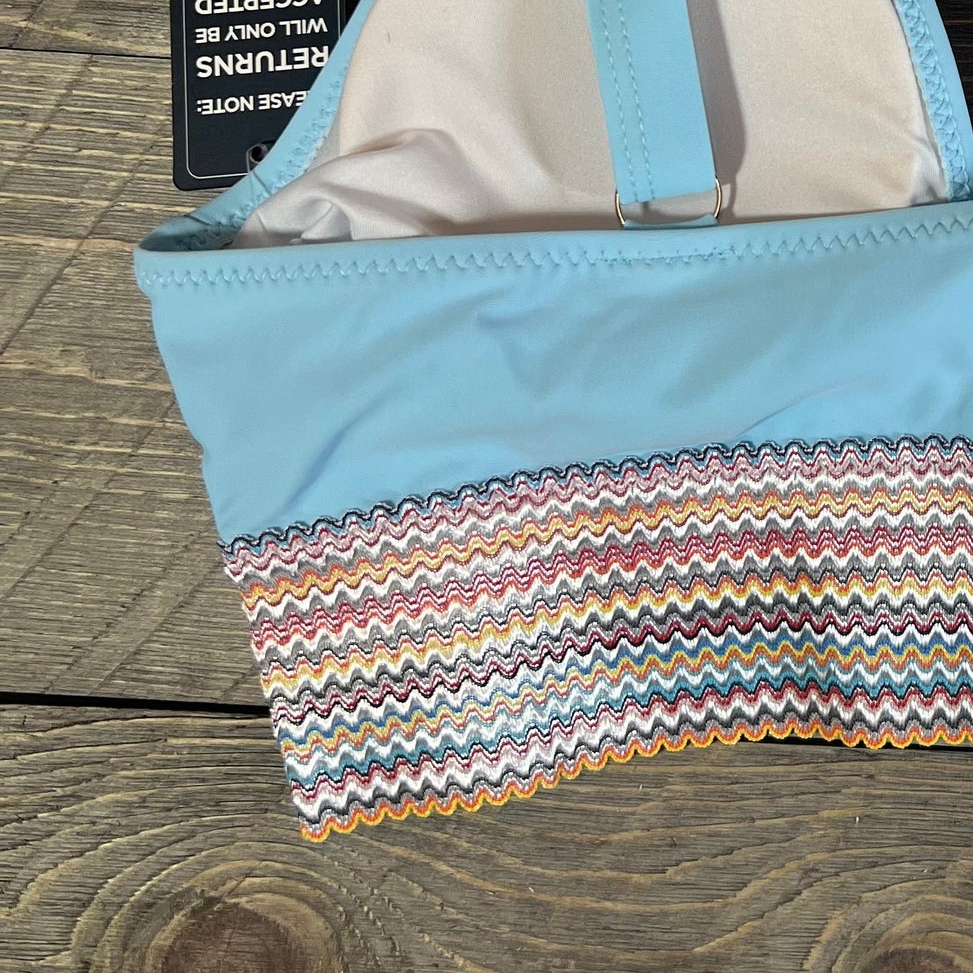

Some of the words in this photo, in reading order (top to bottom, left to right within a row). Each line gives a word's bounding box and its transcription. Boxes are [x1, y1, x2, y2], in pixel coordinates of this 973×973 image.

[194, 26, 221, 44] BE
[224, 22, 276, 42] ONLY
[278, 17, 328, 38] WILL
[195, 46, 329, 78] RETURNS
[196, 94, 254, 115] NOTE:
[258, 90, 310, 111] EASE
